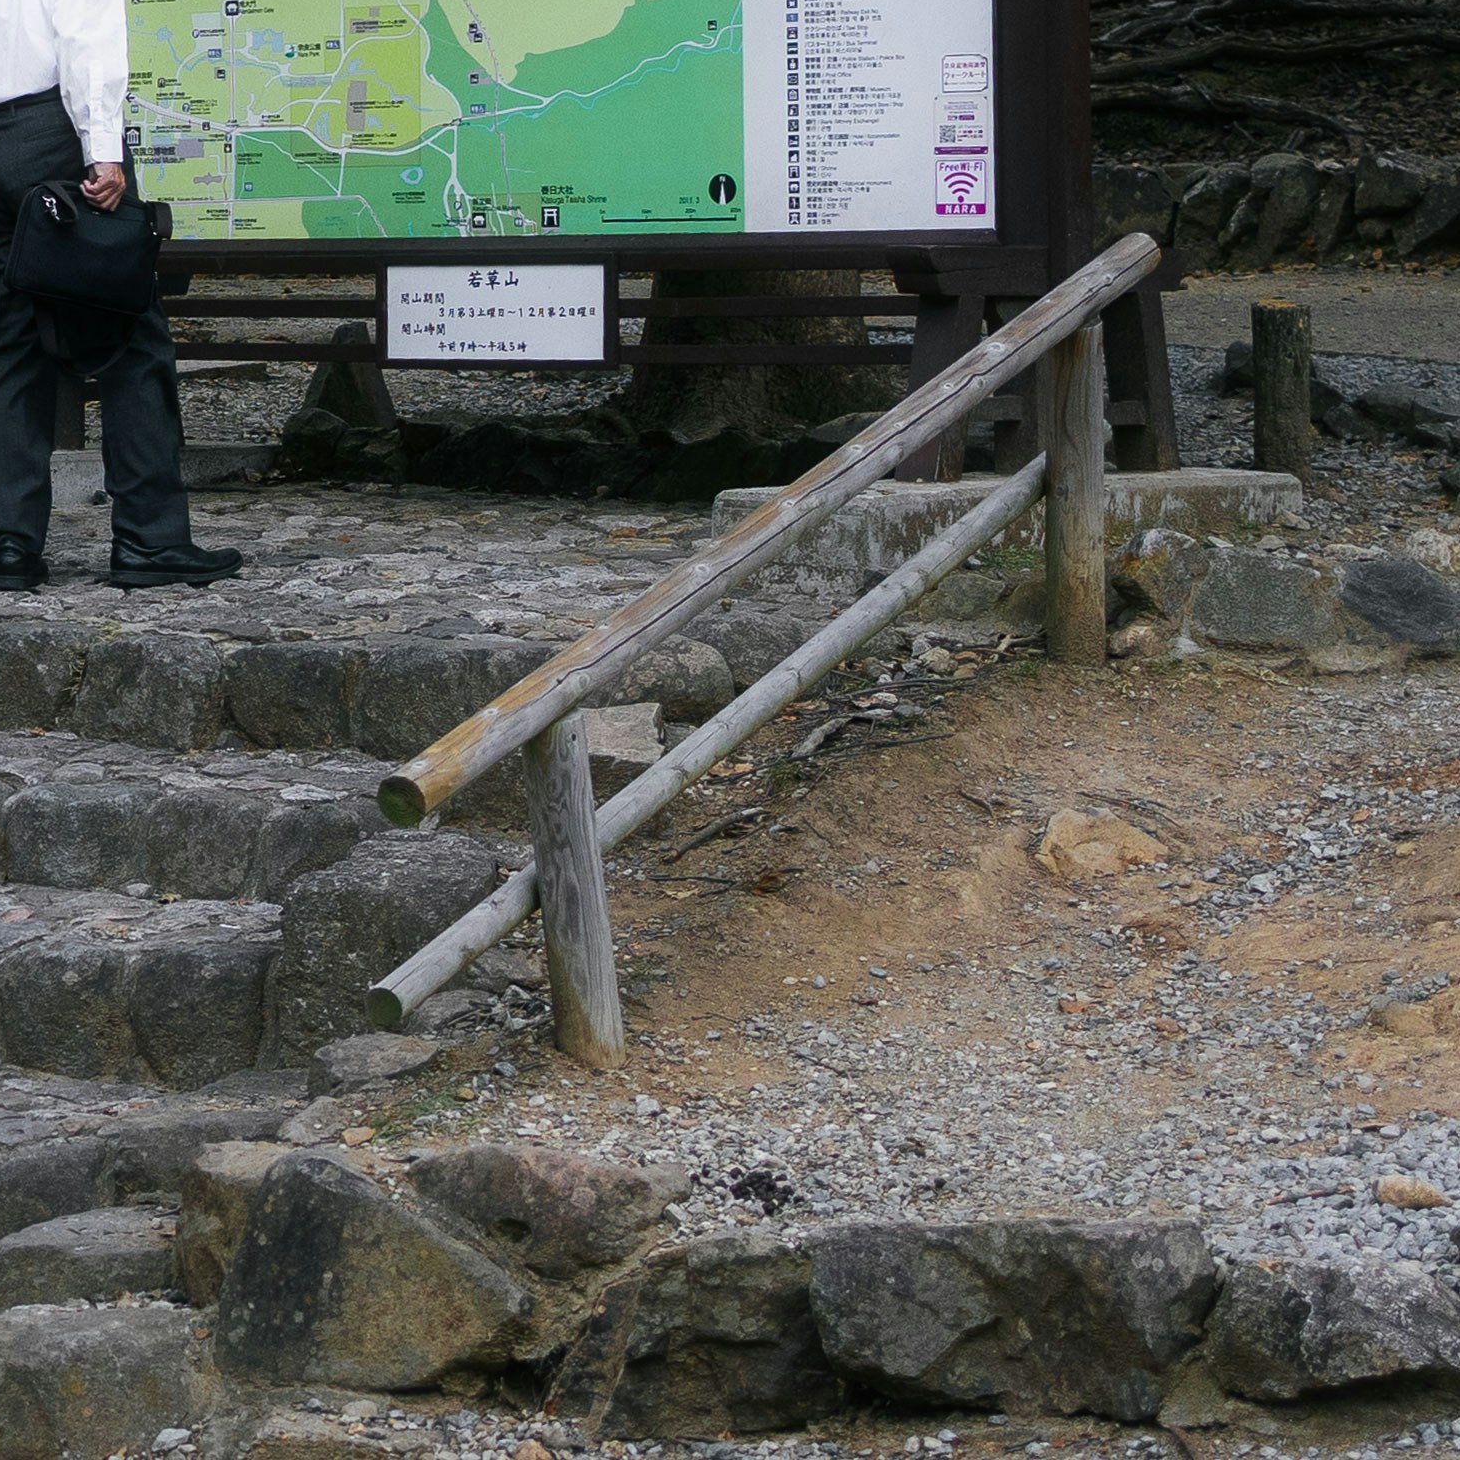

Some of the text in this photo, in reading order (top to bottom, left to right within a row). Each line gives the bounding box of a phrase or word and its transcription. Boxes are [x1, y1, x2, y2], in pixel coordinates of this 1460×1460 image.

[939, 162, 983, 172] Free Wi-Fi
[587, 195, 607, 203] Shrine
[945, 205, 977, 214] NARA
[467, 270, 519, 290] 若草山
[401, 324, 446, 336] 開山時間
